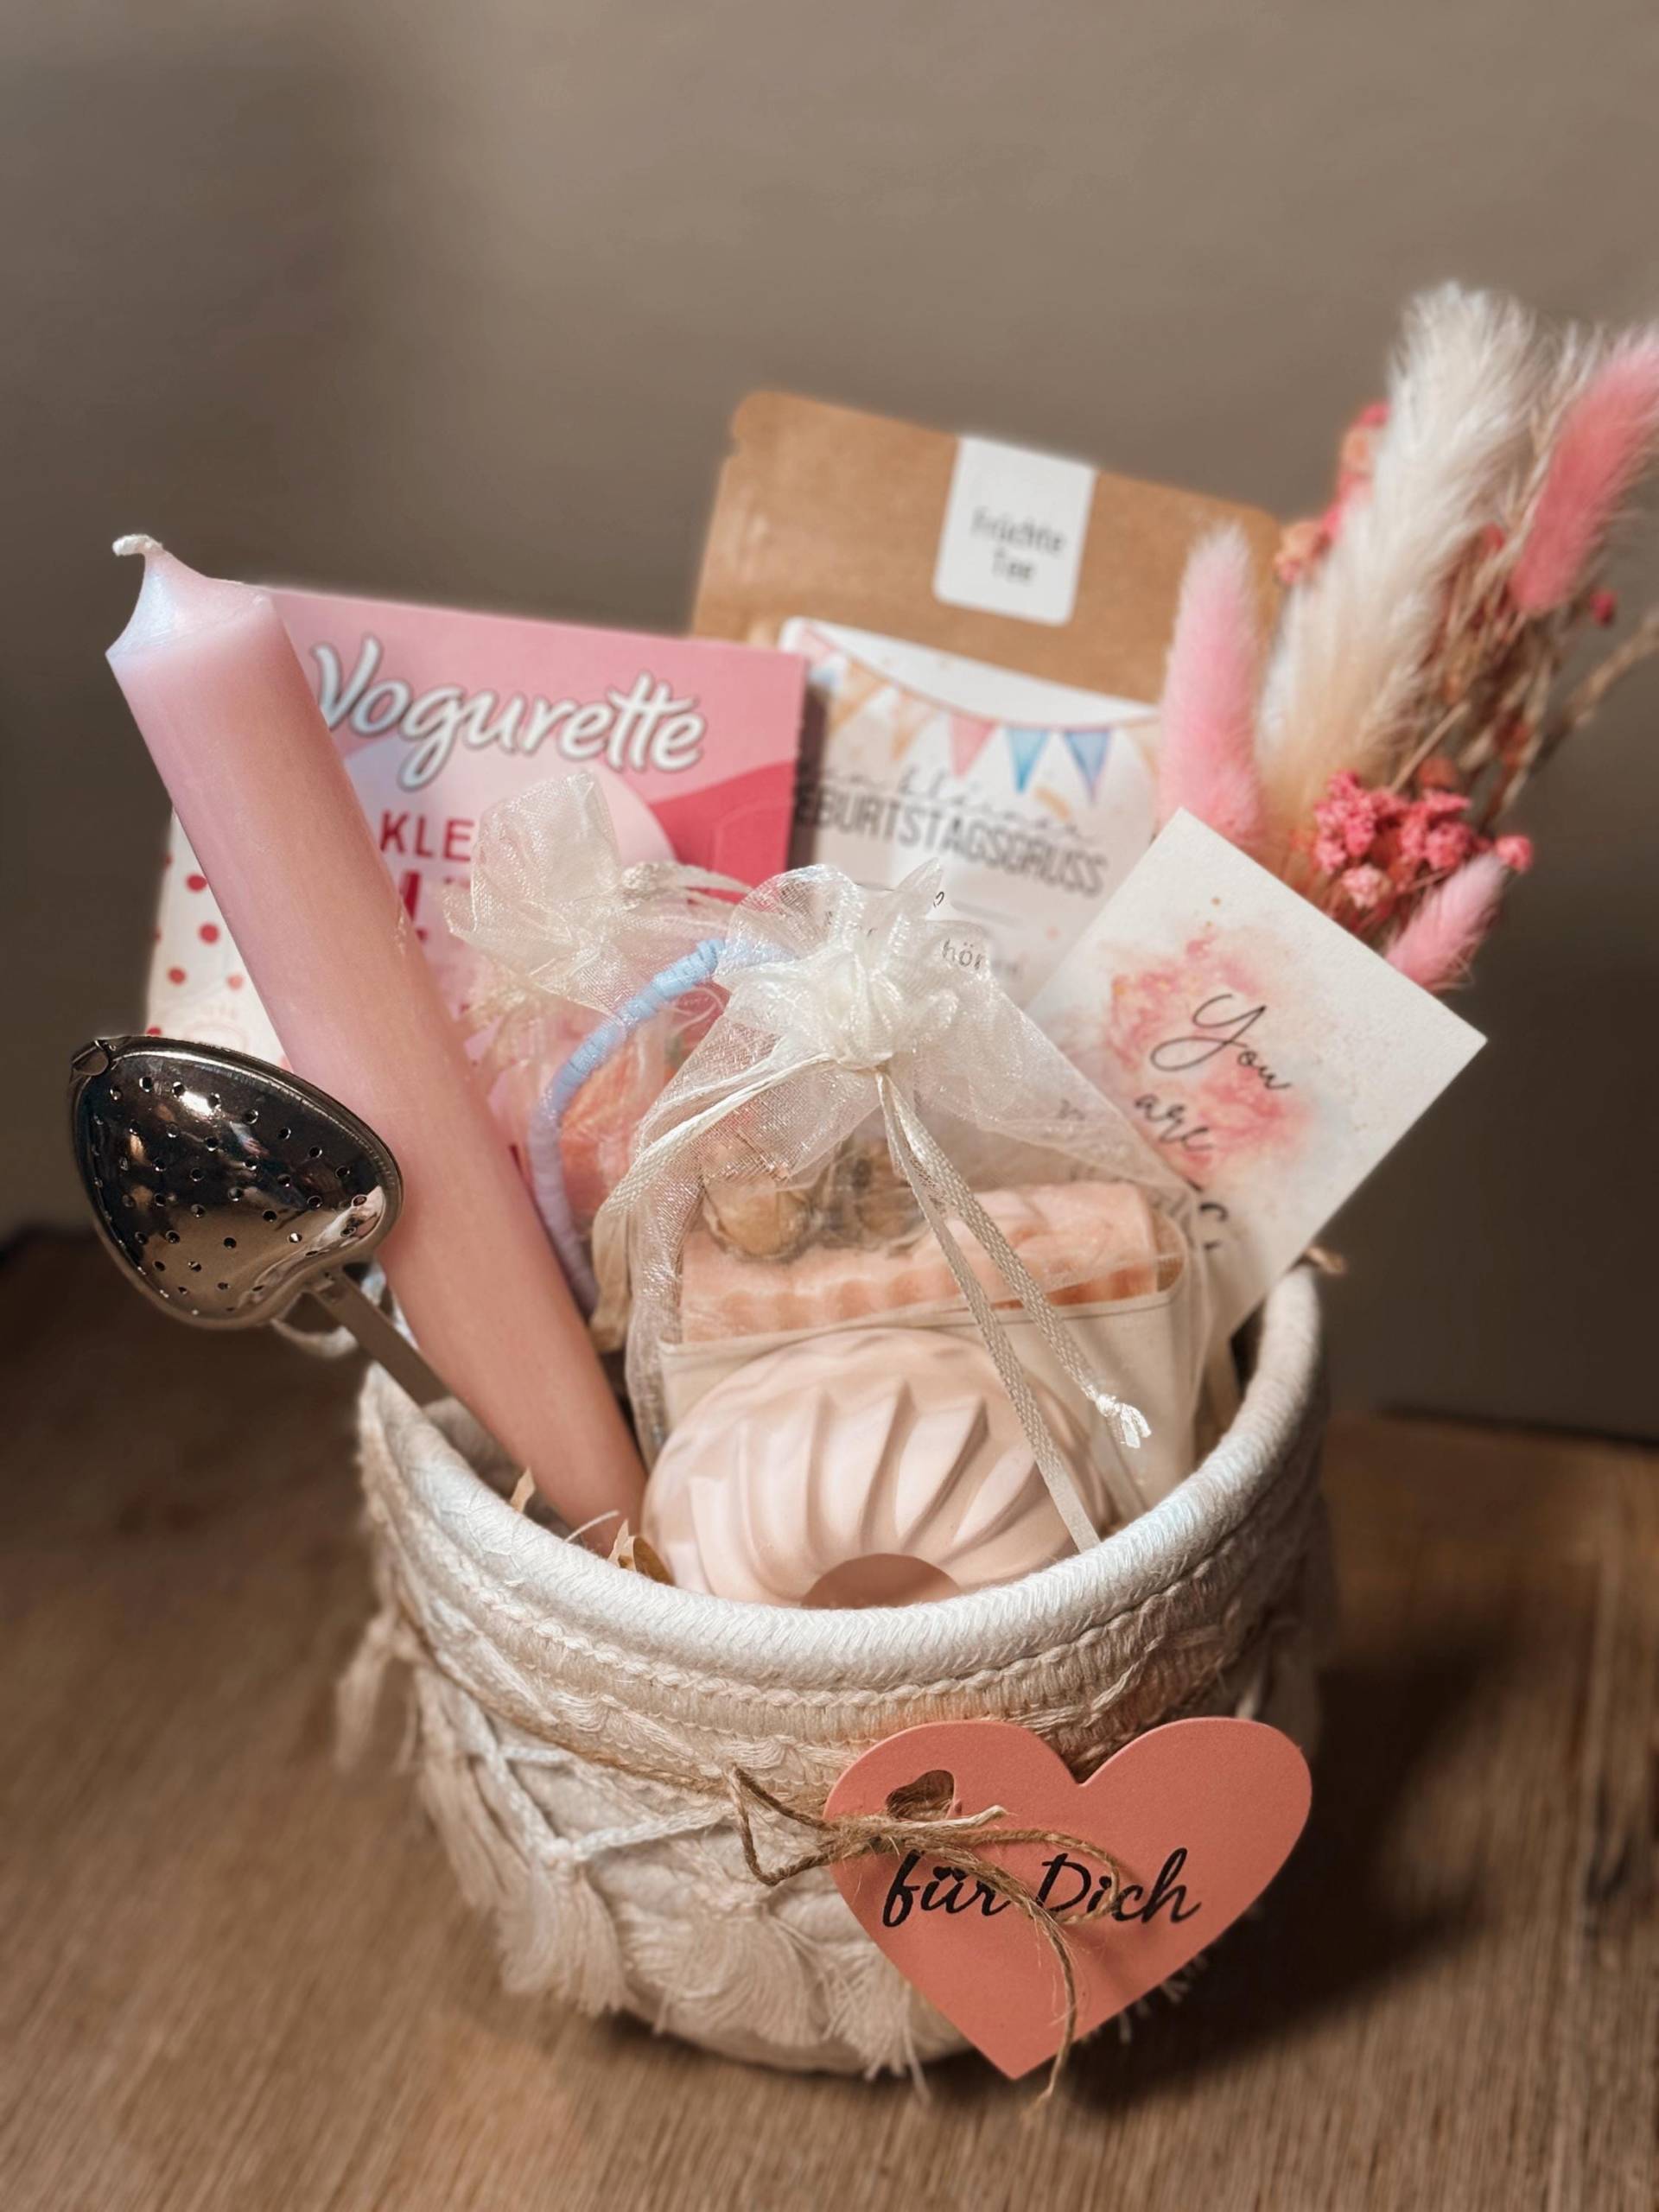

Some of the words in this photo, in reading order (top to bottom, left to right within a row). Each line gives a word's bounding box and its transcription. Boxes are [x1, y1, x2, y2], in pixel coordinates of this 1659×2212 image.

[380, 809, 474, 862] KLE
[1149, 993, 1292, 1091] You
[1134, 1092, 1215, 1153] are
[881, 1848, 1010, 1928] für
[1035, 1847, 1202, 1924] Dich
